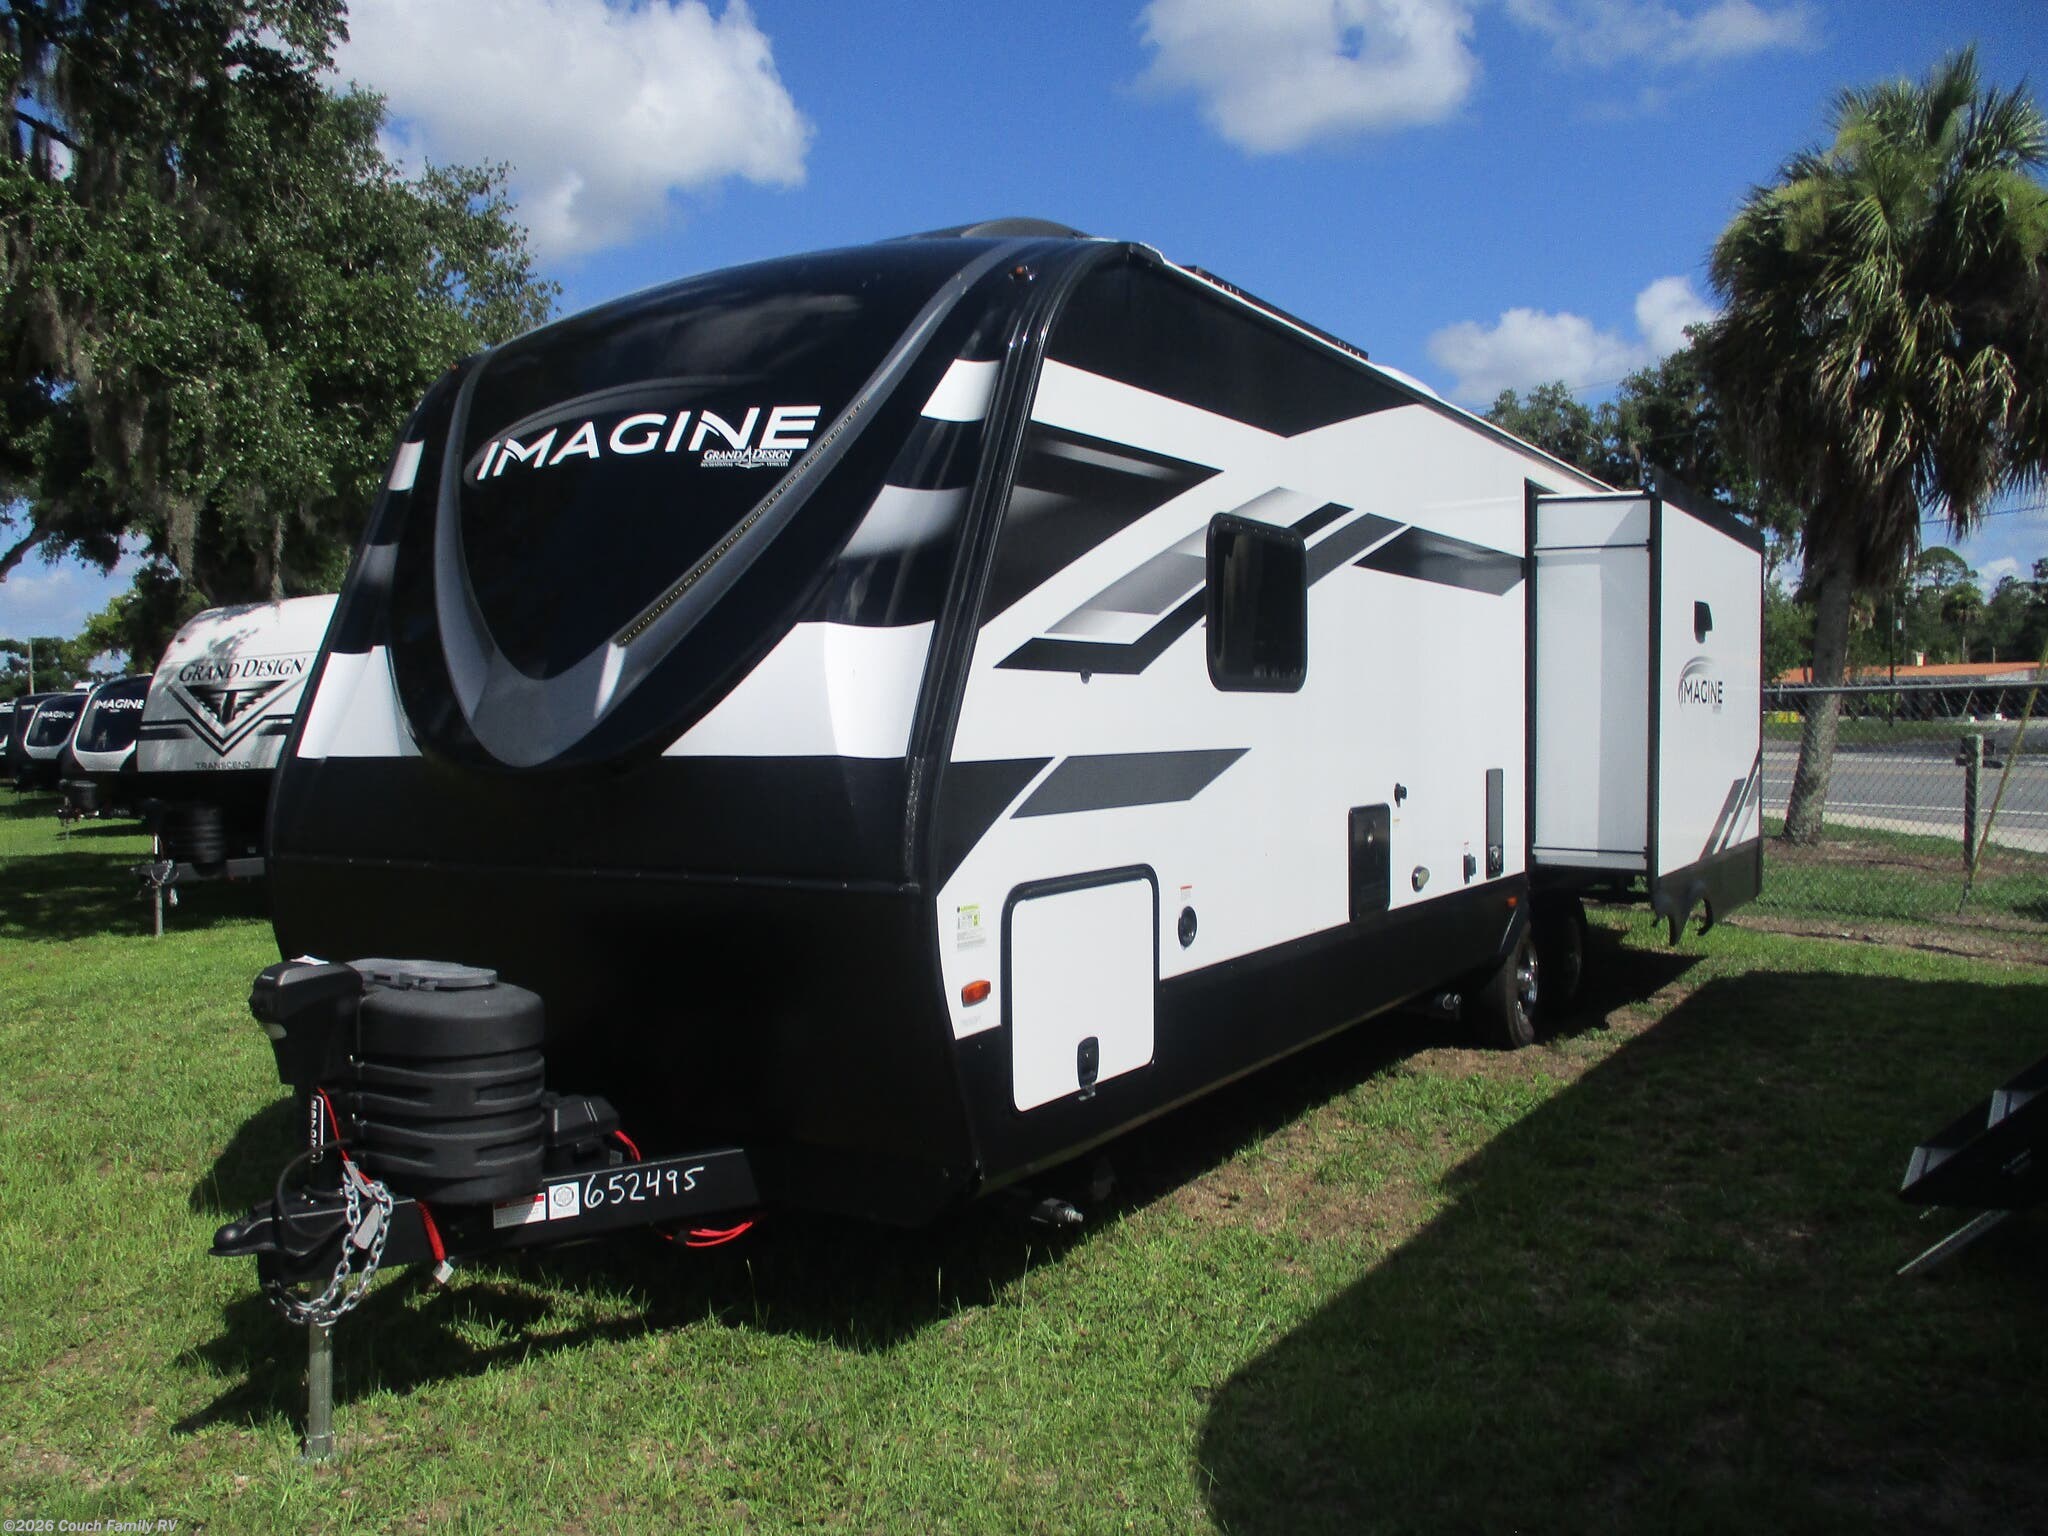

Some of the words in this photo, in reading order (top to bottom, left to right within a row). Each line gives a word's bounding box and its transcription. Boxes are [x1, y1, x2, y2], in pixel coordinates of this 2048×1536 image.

[477, 405, 821, 481] IMAGINE
[703, 448, 742, 461] GRAND
[752, 447, 793, 461] DESIGN
[179, 662, 240, 683] GRAND
[242, 657, 307, 679] DESIGN
[93, 698, 145, 710] IMAGINE
[1680, 679, 1723, 705] IMAGINE
[194, 760, 252, 770] TRANSCEND
[583, 1166, 705, 1209] 652495
